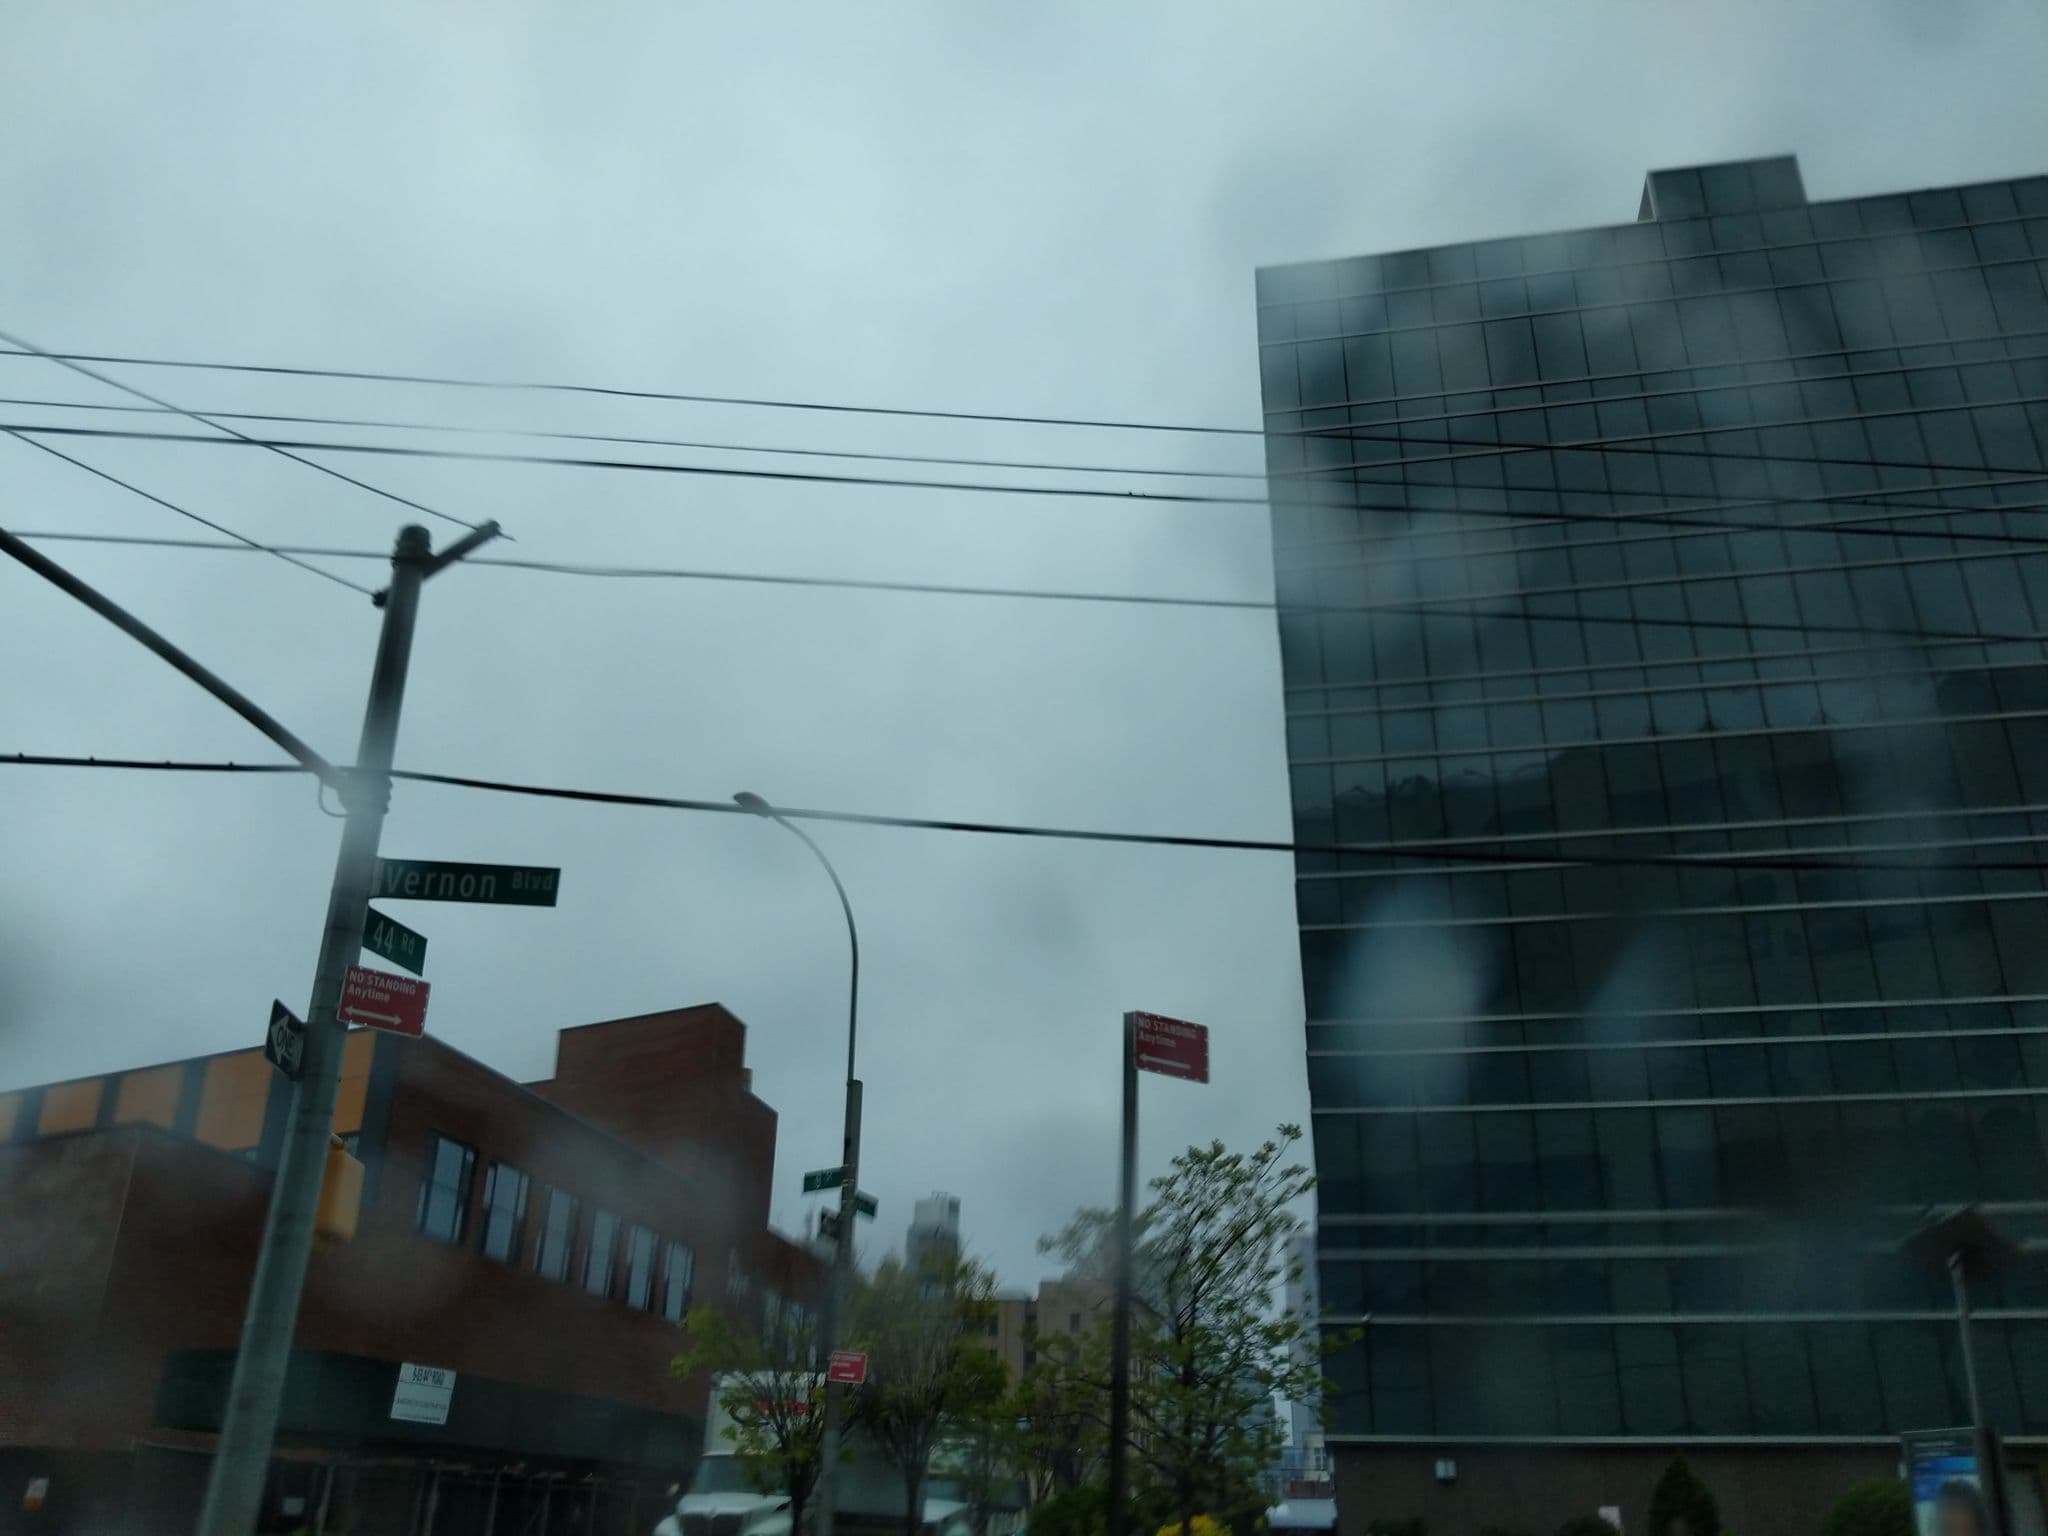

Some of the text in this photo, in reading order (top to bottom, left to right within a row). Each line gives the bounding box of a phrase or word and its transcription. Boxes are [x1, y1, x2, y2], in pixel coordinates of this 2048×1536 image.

[386, 863, 554, 899] Vernon Blvd
[373, 920, 395, 954] 44
[347, 983, 391, 1004] Anytime
[349, 970, 417, 996] NO STANDING
[1138, 1017, 1151, 1029] NO
